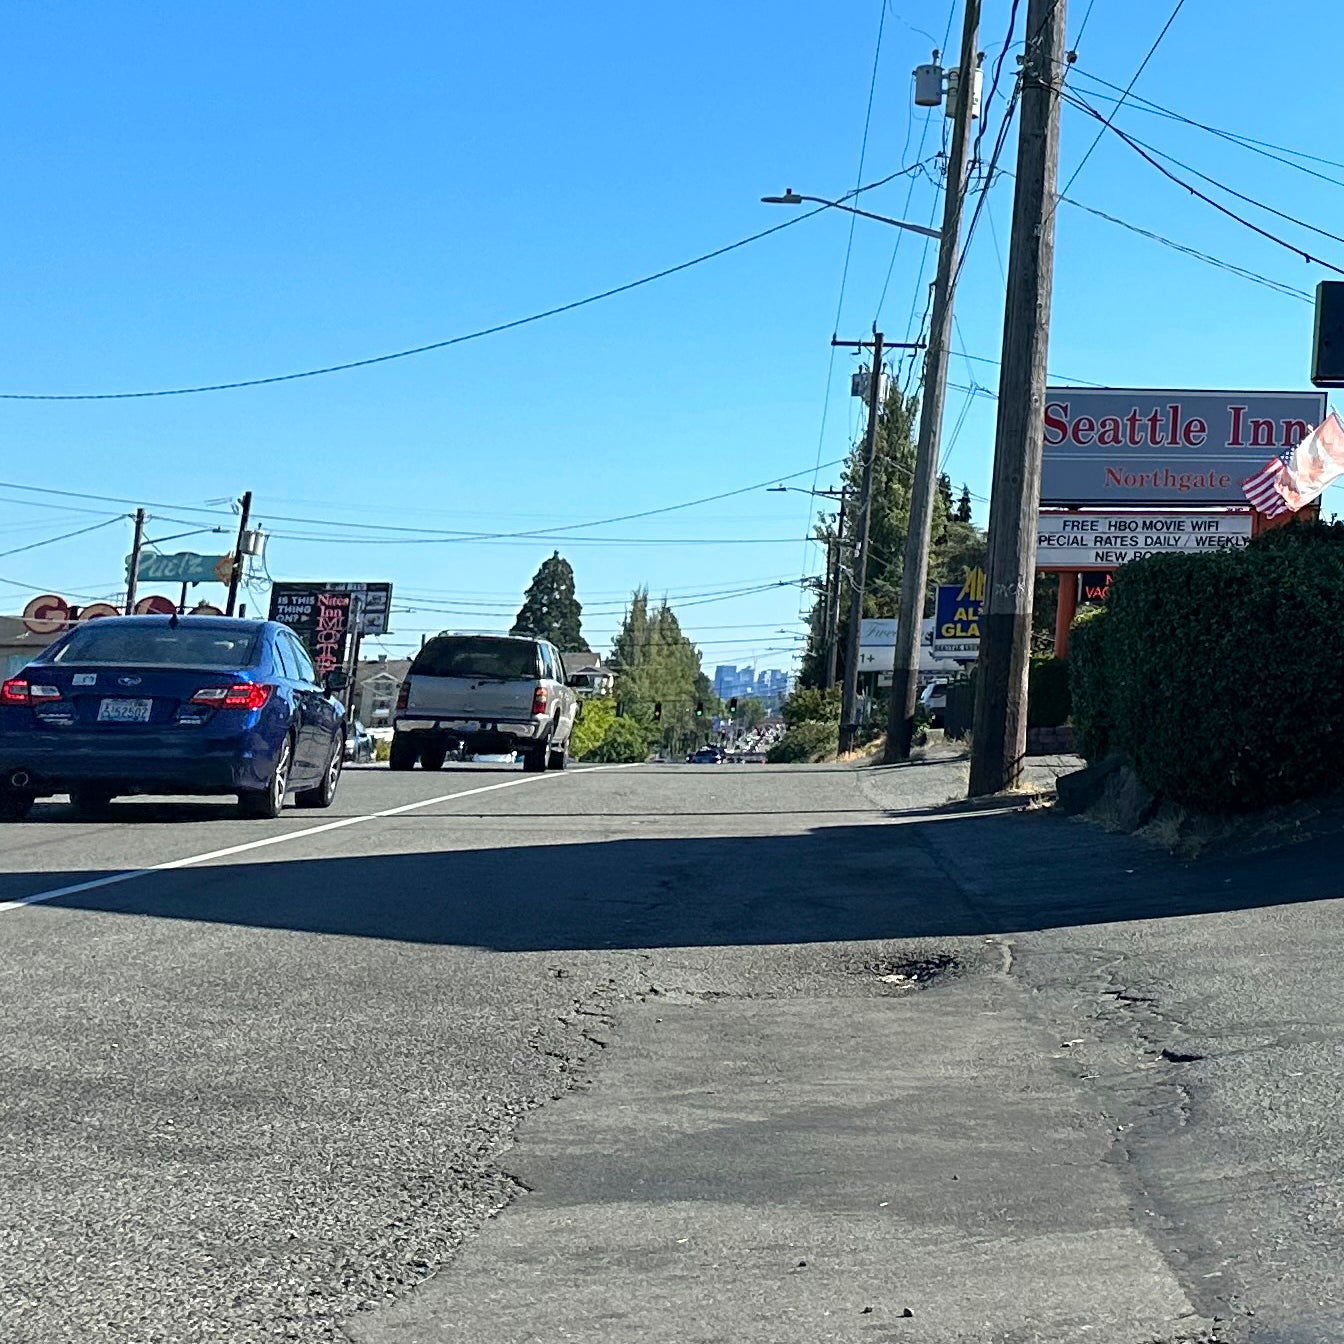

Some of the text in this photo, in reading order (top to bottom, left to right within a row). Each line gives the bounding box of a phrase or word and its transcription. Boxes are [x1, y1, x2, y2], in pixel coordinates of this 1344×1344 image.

[1043, 401, 1311, 448] Seattle Inn
[1103, 466, 1232, 492] Northgate
[1062, 520, 1219, 532] FREE HBO MOVIE WIFI
[1037, 535, 1088, 547] PECIAL
[1093, 535, 1139, 547] RATES
[1143, 535, 1182, 547] DAILY
[1195, 535, 1250, 547] WEEKLY
[1094, 551, 1128, 562] NEW
[292, 596, 315, 605] THIS
[278, 605, 312, 613] THING
[319, 605, 342, 617] Inn
[941, 623, 980, 637] GLA
[315, 617, 345, 673] MOTE
